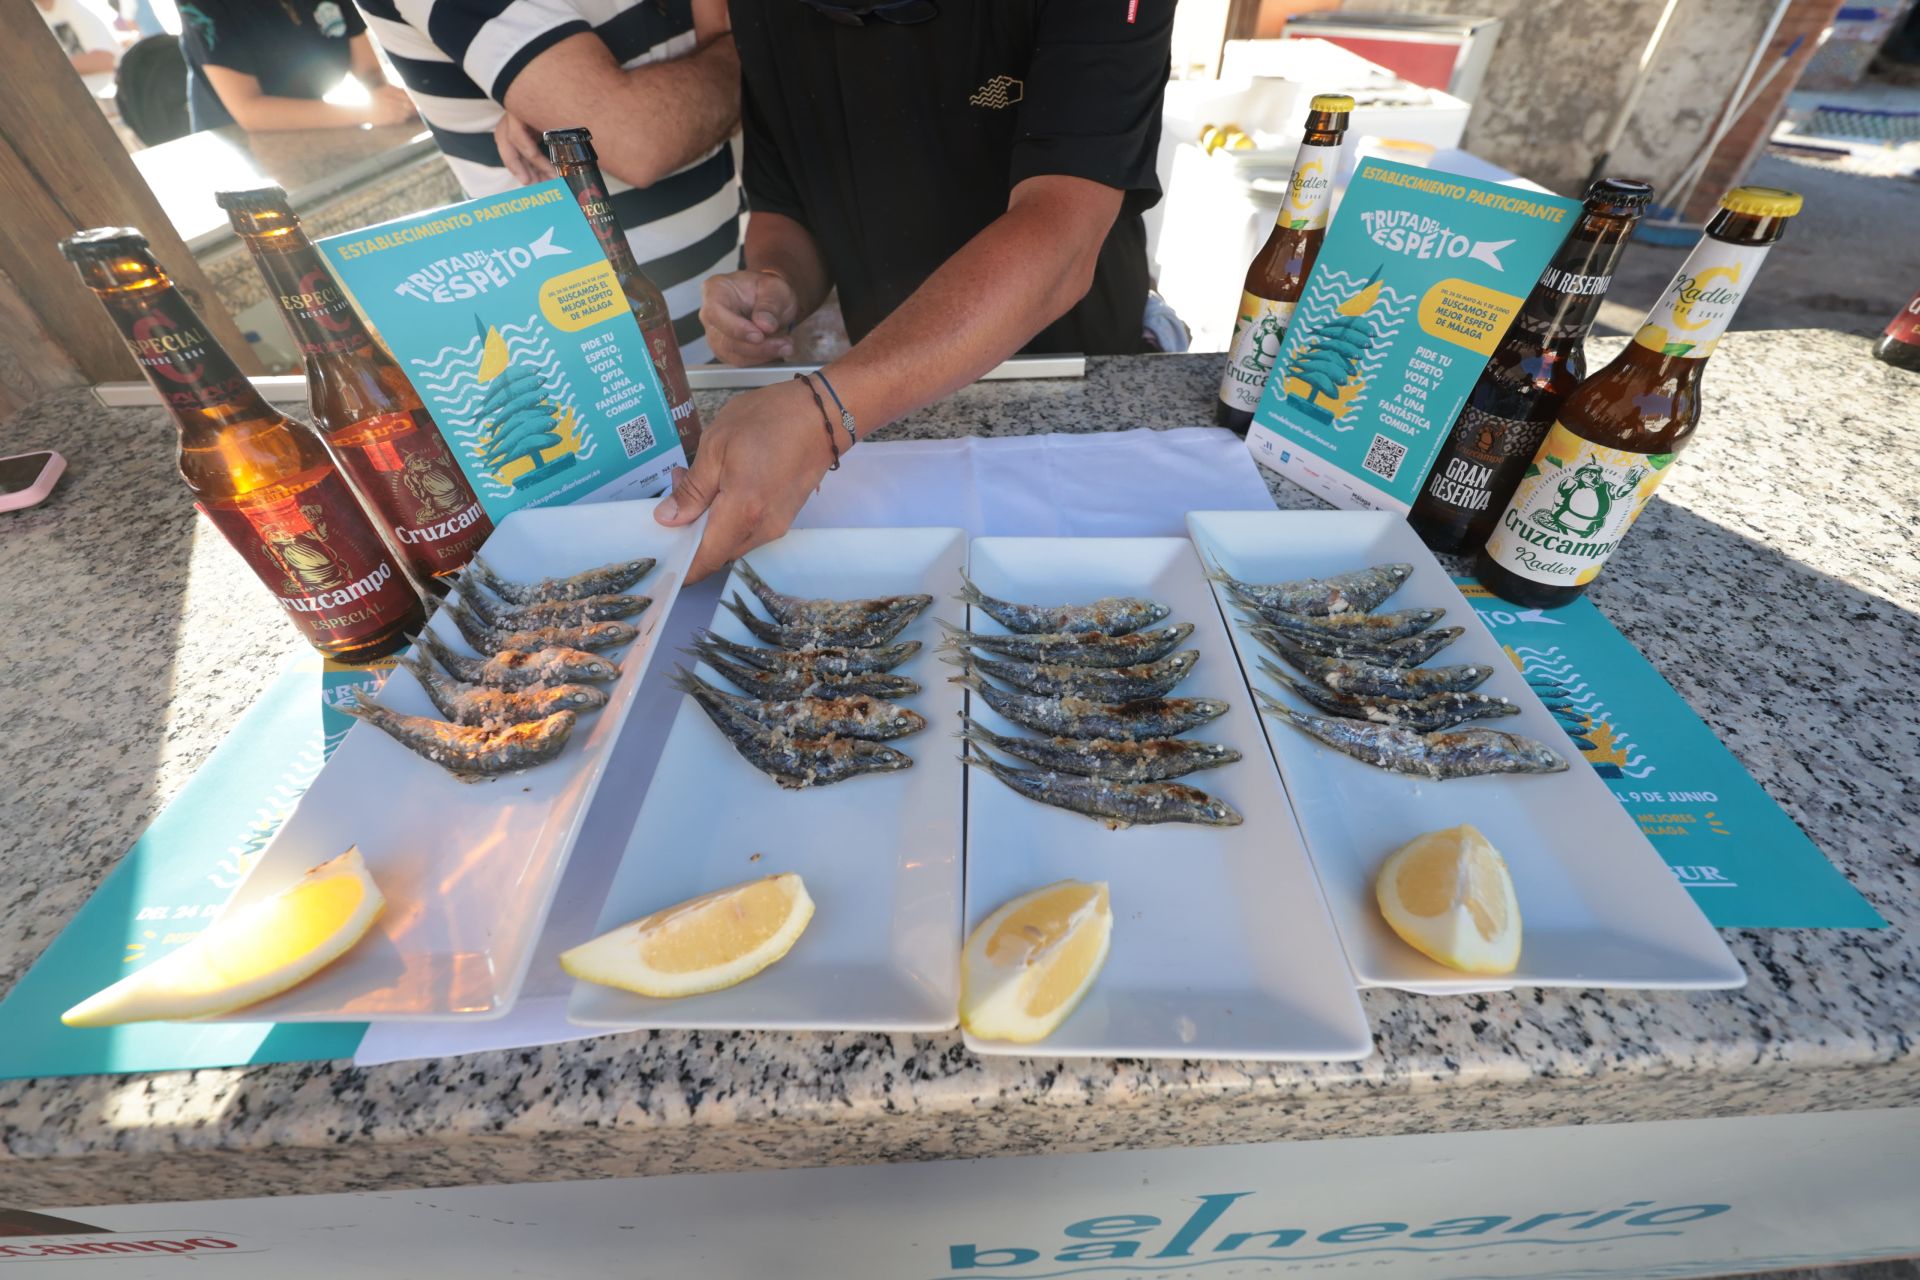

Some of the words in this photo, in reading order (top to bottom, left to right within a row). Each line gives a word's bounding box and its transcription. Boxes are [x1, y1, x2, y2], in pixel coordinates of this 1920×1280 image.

[1290, 170, 1328, 191] Radler
[1362, 166, 1466, 200] ESTABLECIMIENTO
[1466, 189, 1568, 223] PARTICIPANTE
[337, 213, 473, 260] ESTABLECIMIENTO
[473, 188, 564, 223] PARTICIPANTE
[1420, 216, 1441, 234] DEL
[1372, 225, 1470, 259] ESPETO
[462, 249, 491, 269] DEL
[432, 246, 532, 303] ESPETO
[1540, 265, 1561, 288] AN
[557, 284, 600, 304] BUSCAMOS
[599, 281, 609, 289] EL
[1671, 273, 1740, 305] Radler
[561, 299, 587, 313] MEJOR
[587, 289, 614, 303] ESPETO
[1441, 297, 1488, 318] BUSCAMOS
[1488, 313, 1498, 322] EL
[570, 312, 581, 321] DE
[1435, 306, 1463, 321] MEJOR
[1463, 316, 1495, 332] ESPETO
[1435, 317, 1447, 327] DE
[128, 328, 207, 355] SPECIAL
[580, 337, 602, 352] PIDE
[602, 331, 615, 343] TU
[584, 344, 620, 364] ESPETO,
[590, 358, 616, 374] VOTA
[616, 354, 623, 363] Y
[1415, 345, 1438, 362] PIDE
[1438, 354, 1453, 367] TU
[600, 367, 625, 383] OPTA
[1404, 369, 1429, 388] VOTA
[1432, 380, 1440, 391] Y
[1408, 357, 1444, 381] ESPETO,
[595, 382, 646, 411] FANTÁSTICA
[603, 386, 610, 396] A
[610, 376, 632, 391] UNA
[1403, 383, 1428, 401] OPTA
[1378, 399, 1431, 431] FANTÁSTICA
[1394, 393, 1402, 403] A
[1403, 397, 1425, 414] UNA
[1445, 457, 1493, 489] GRAN
[1429, 472, 1492, 511] RESERVA
[395, 501, 484, 545] Cruzcam
[1505, 508, 1620, 560] Cruzcampo
[1514, 546, 1577, 576] Radler
[311, 602, 384, 631] ESPECIAL
[1616, 791, 1629, 802] L
[1629, 791, 1641, 802] 9
[1641, 791, 1665, 802] DE
[1667, 791, 1719, 802] JUNIO
[136, 906, 171, 920] DEL
[0, 1236, 238, 1259] campo
